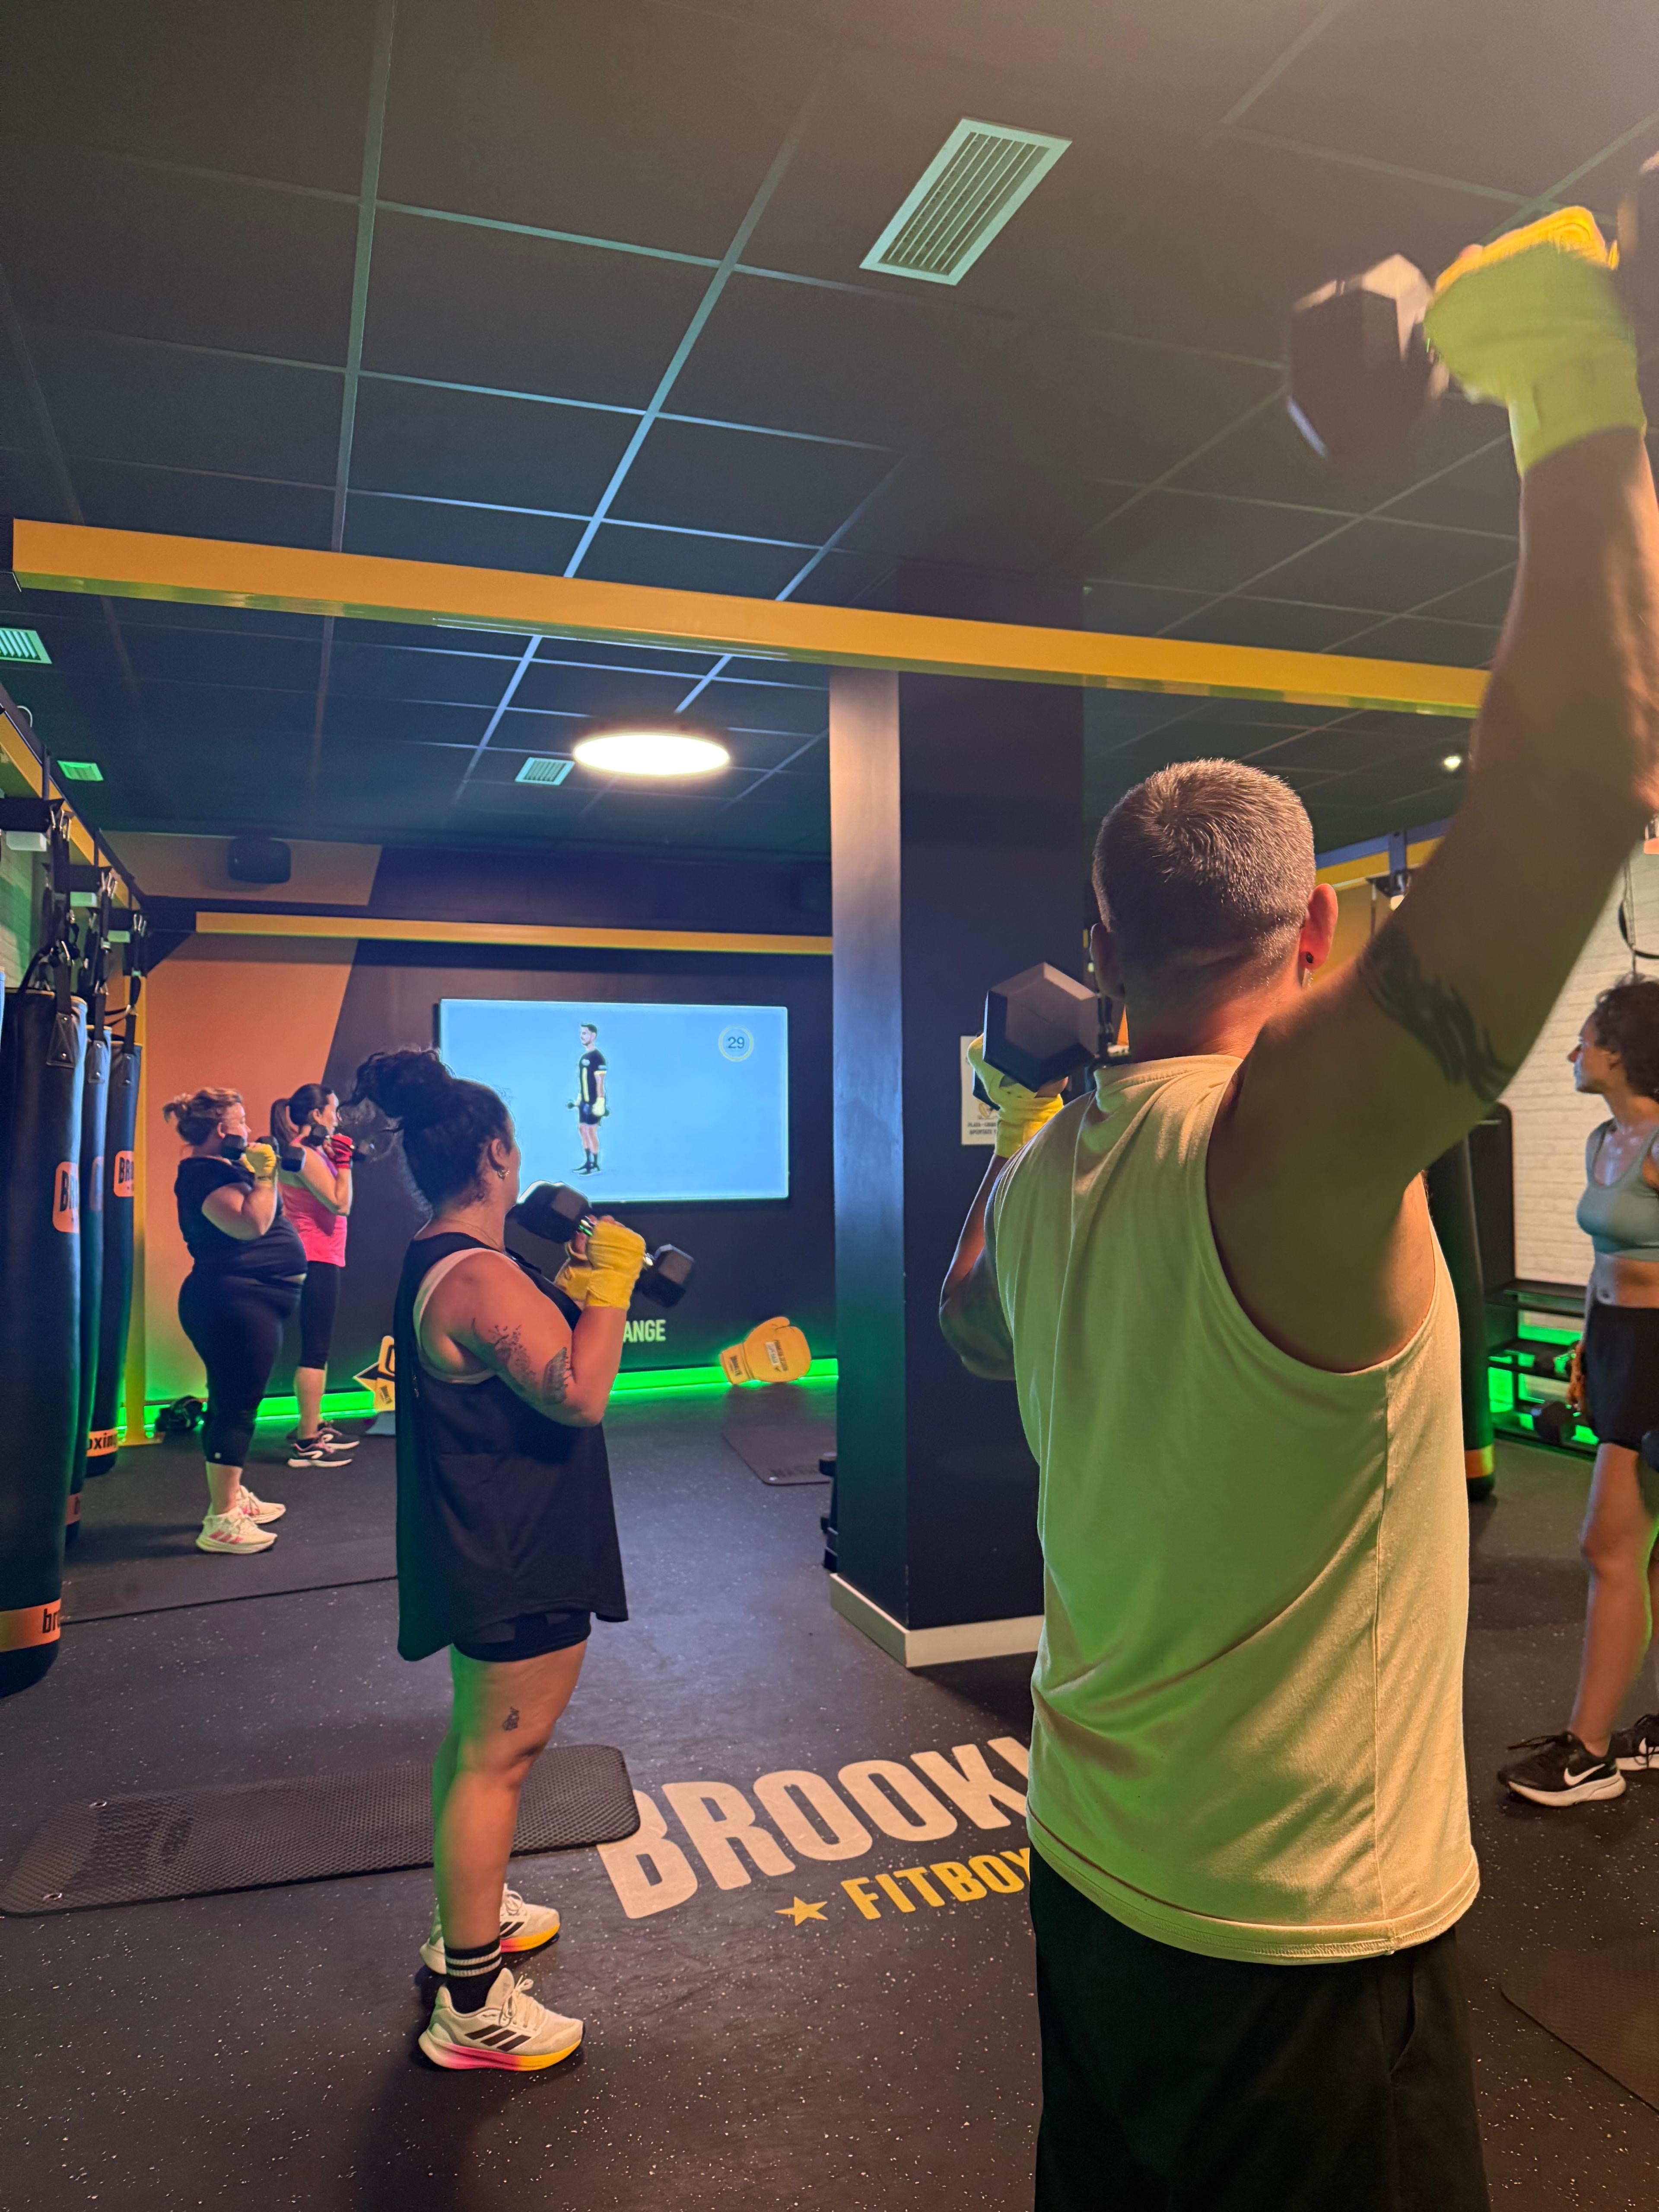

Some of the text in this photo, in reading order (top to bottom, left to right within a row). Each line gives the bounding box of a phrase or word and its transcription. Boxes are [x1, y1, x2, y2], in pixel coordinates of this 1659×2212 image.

[728, 1036, 745, 1049] 29
[623, 1319, 666, 1343] ANGE
[42, 1608, 60, 1634] br
